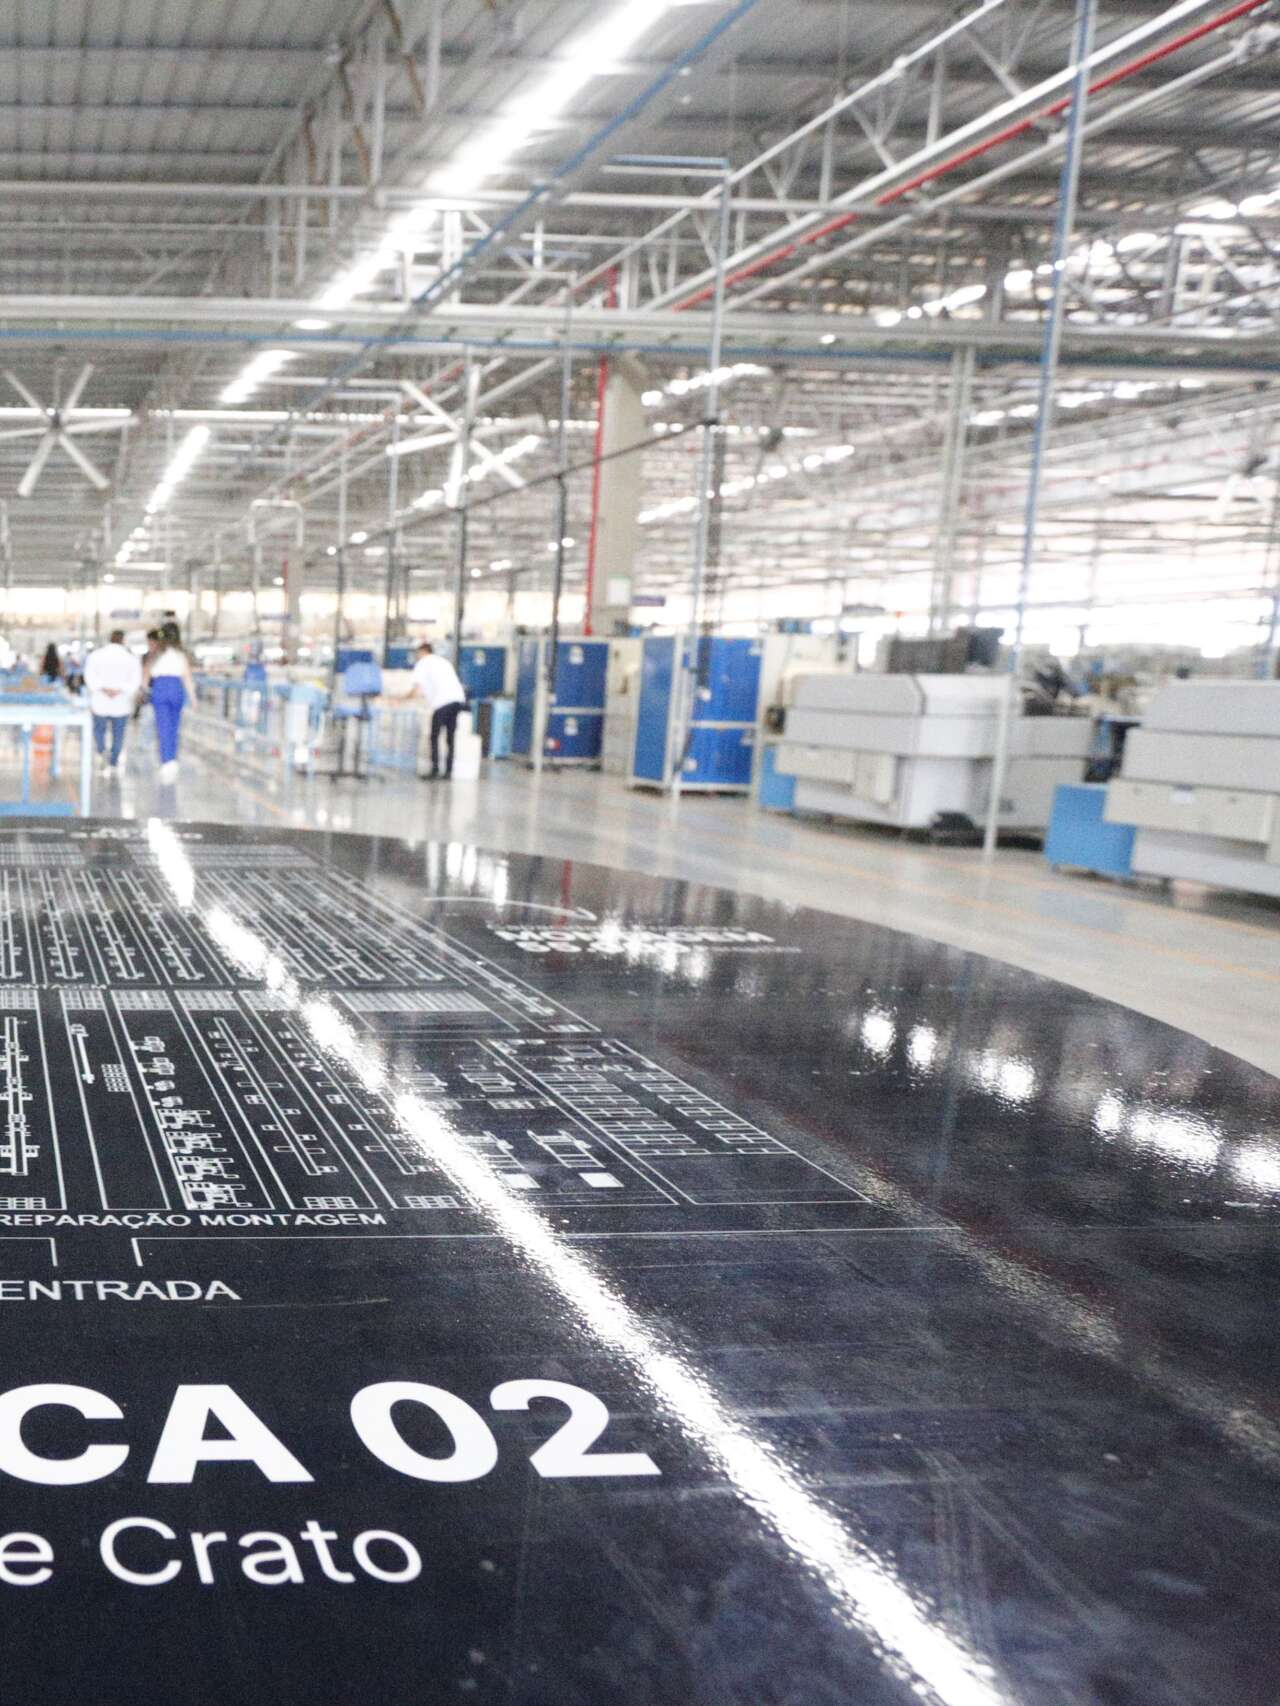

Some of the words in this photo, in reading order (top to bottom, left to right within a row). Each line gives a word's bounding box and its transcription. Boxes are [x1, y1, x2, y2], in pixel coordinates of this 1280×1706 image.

[199, 1213, 388, 1226] MONTAGEM
[347, 1379, 662, 1484] 02
[99, 1516, 425, 1586] Crato
